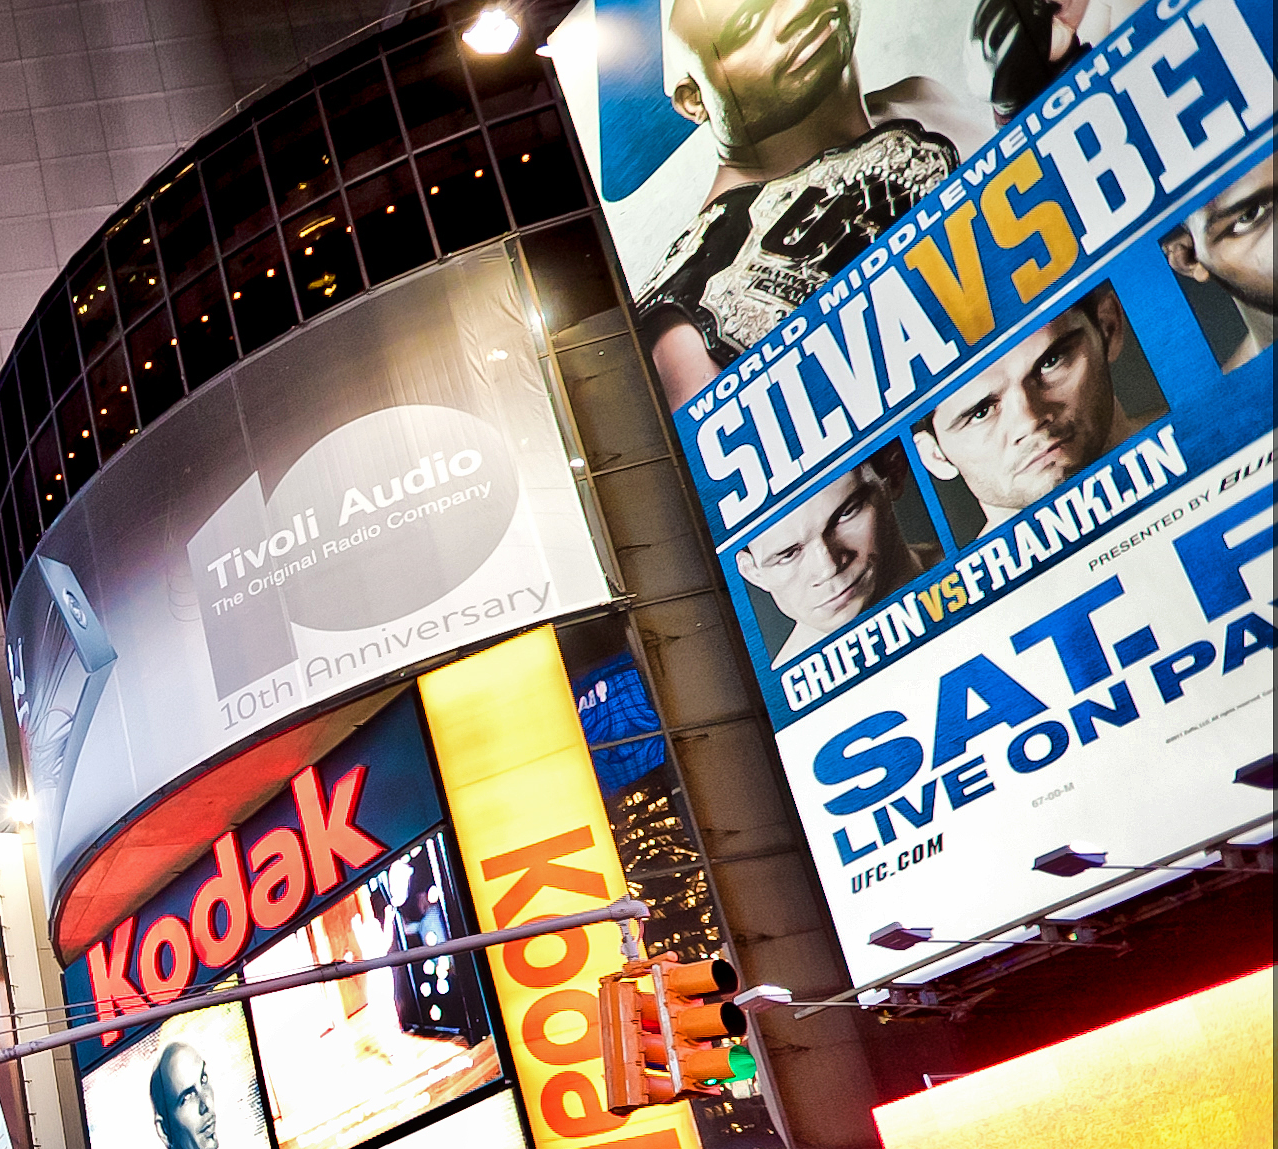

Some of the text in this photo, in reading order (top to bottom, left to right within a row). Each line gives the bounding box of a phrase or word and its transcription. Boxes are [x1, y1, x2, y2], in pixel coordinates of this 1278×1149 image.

[687, 23, 1136, 423] WORLD MIDDLEWEIGHT
[695, 277, 960, 532] SILVA
[903, 148, 1079, 348] VS
[206, 447, 483, 590] Tivoli Audio
[211, 480, 493, 617] The Original Radio Company
[780, 423, 1189, 714] GRIFFIN VS FRANKLIN
[1087, 502, 1186, 572] PRESENTED
[1186, 488, 1213, 511] BY
[219, 580, 553, 732] 10th Anniversary
[811, 478, 1273, 818] SAT. F
[832, 611, 1273, 869] LIVE ON PA
[85, 764, 390, 1048] Kodak
[850, 832, 946, 894] UFC.COM
